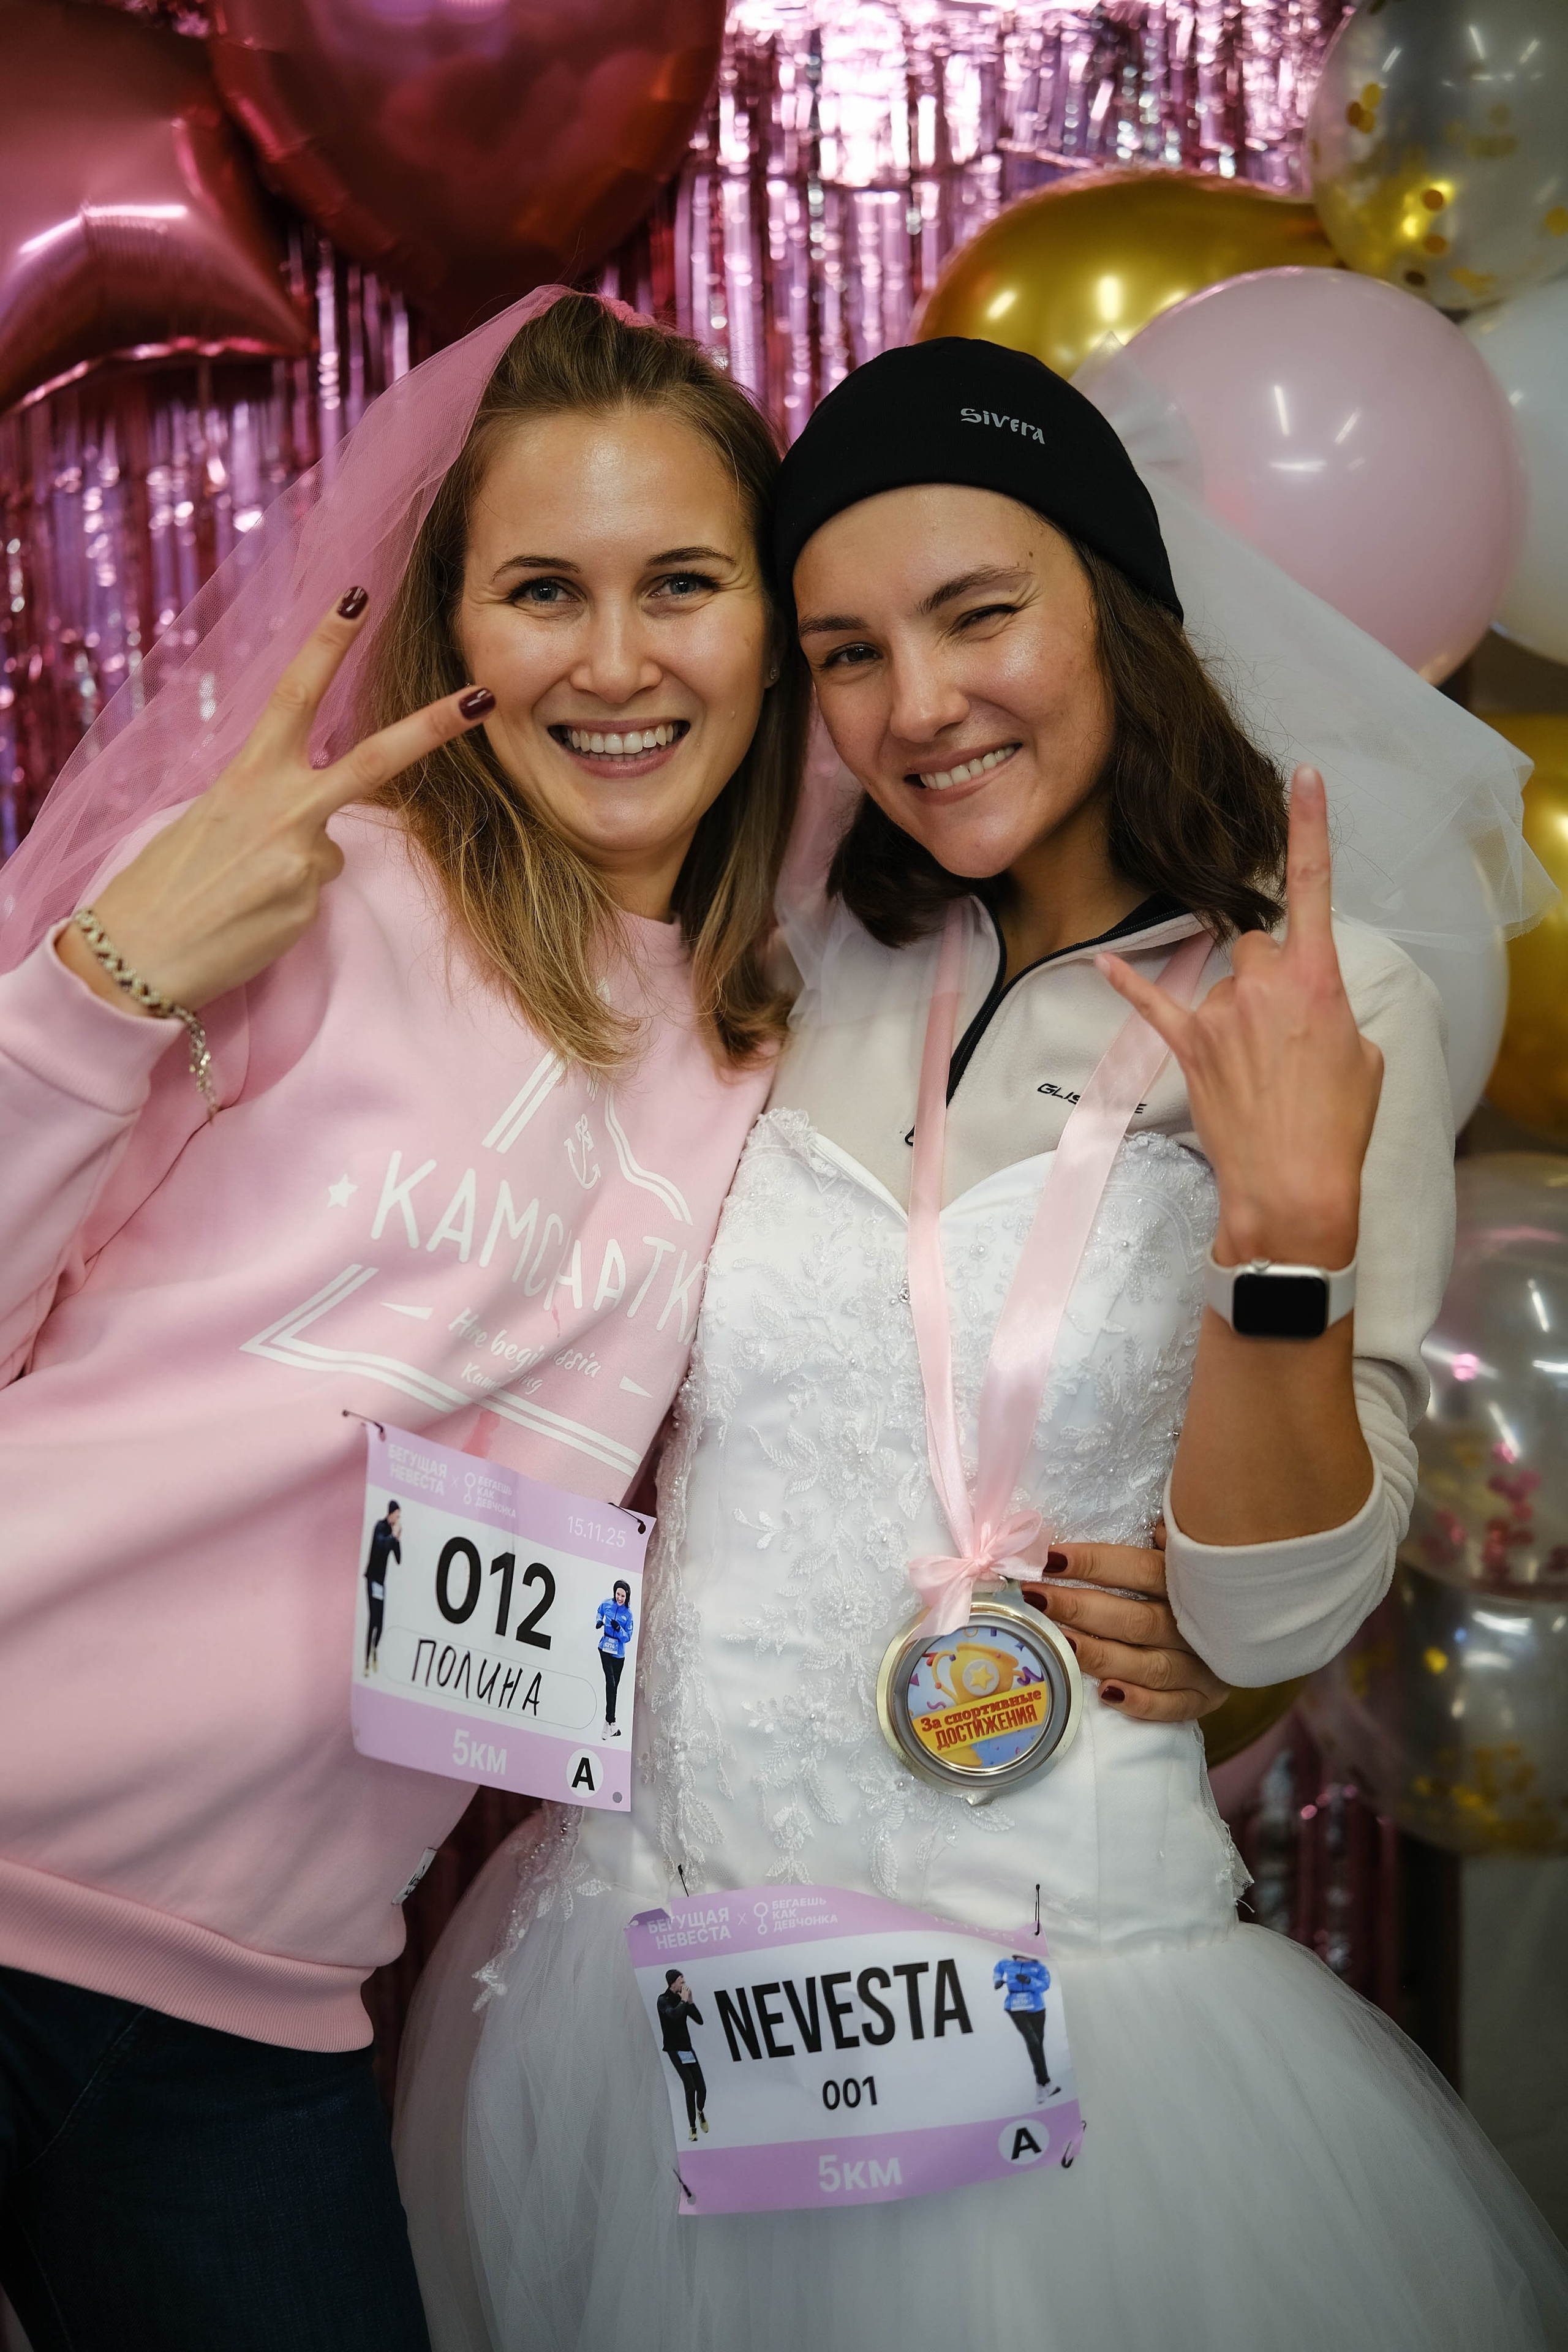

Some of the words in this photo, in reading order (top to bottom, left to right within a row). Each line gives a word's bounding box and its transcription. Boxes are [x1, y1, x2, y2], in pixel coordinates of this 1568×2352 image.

[1037, 1083, 1147, 1114] GLISE
[371, 1150, 704, 1346] KAMCHATK
[388, 1444, 448, 1479] БЕГУЩАЯ
[389, 1462, 444, 1496] НЕВЕСТА
[477, 1486, 494, 1499] КАК
[478, 1476, 513, 1496] БЕГАЕШЬ
[475, 1496, 516, 1518] ДЕВЧОНКА
[567, 1515, 625, 1548] 15.11.25
[435, 1536, 557, 1650] 012
[411, 1638, 542, 1716] ПОЛИНА
[921, 1717, 942, 1732] За
[944, 1690, 1042, 1725] спортивные
[935, 1704, 1038, 1751] ДОСТИЖЕНИЯ
[772, 1897, 827, 1910] БЕГАЕШЬ
[772, 1908, 796, 1920] КАК
[655, 1925, 732, 1950] НЕВЕСТА
[773, 1914, 839, 1932] ДЕВЧОНКА
[714, 1958, 973, 2062] NEVESTA
[822, 2076, 878, 2111] 001
